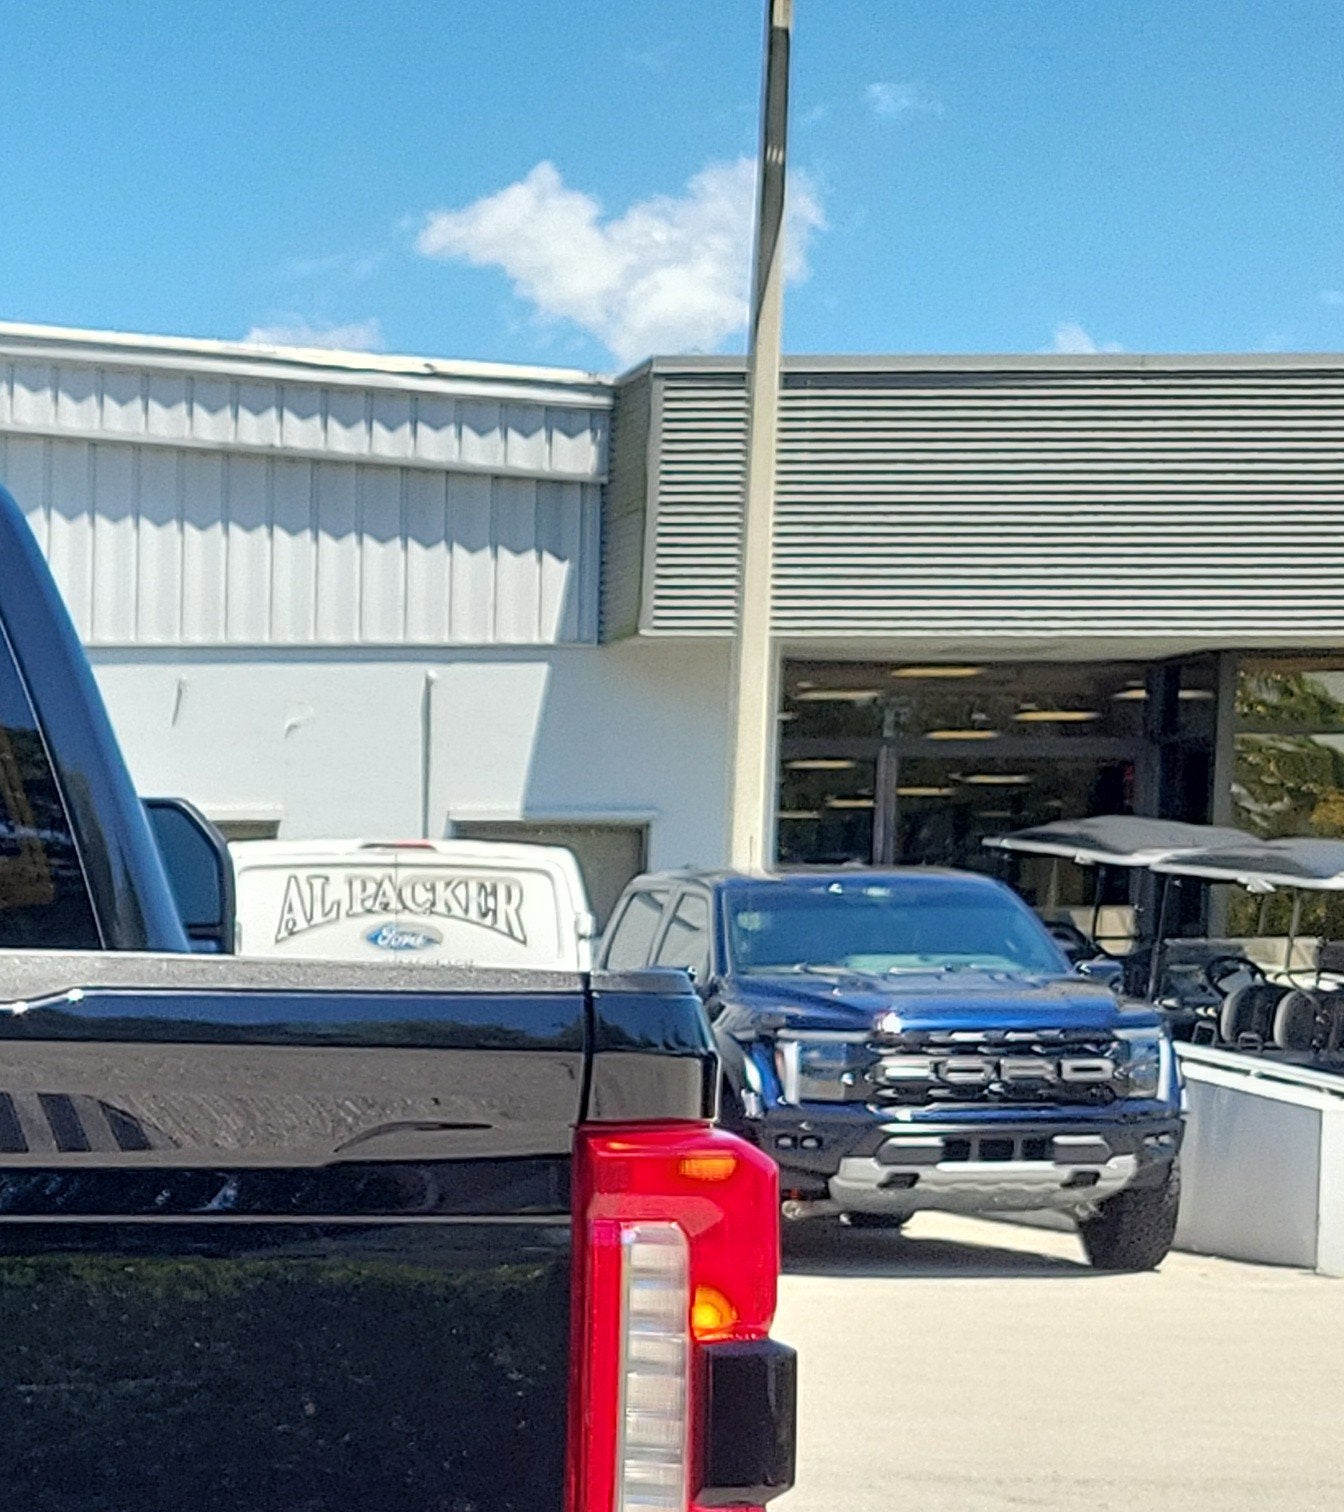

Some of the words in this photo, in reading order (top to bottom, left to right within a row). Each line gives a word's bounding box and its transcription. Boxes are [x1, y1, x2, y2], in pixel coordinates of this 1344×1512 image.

[275, 875, 341, 944] AL
[346, 873, 528, 947] PACKER
[377, 925, 426, 947] Ford
[873, 1055, 1115, 1083] FORD
